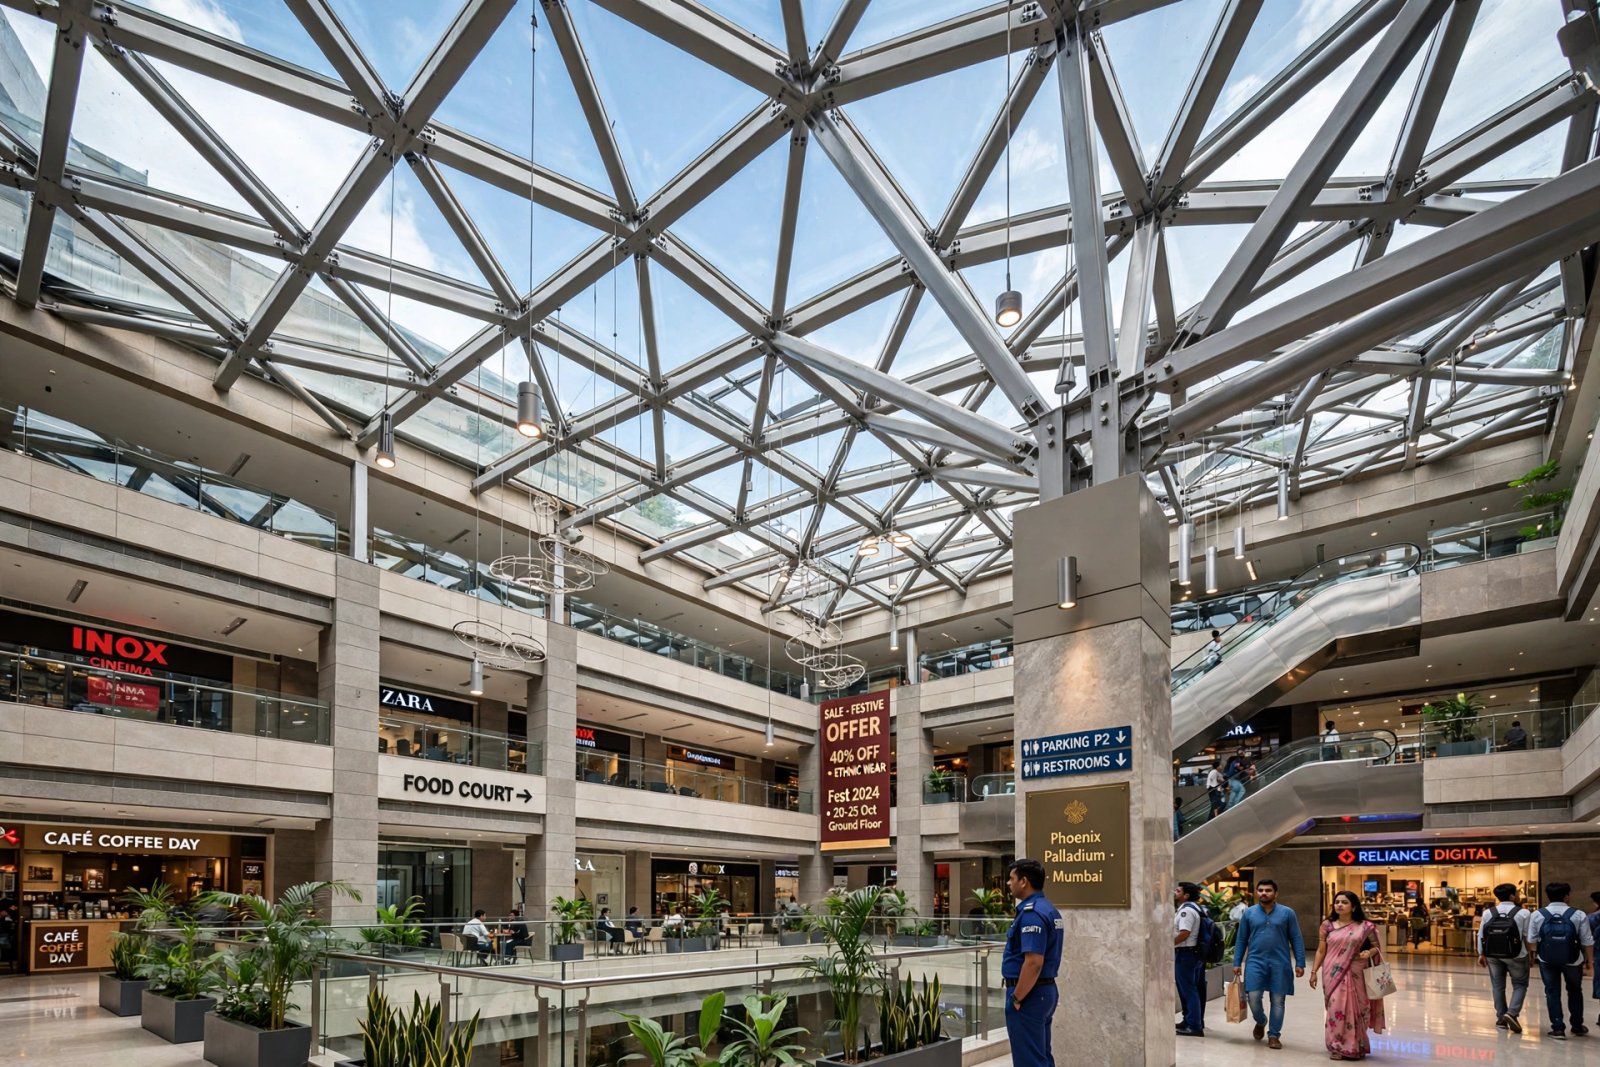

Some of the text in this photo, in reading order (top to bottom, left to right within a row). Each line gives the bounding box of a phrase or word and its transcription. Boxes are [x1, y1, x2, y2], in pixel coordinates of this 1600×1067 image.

[73, 627, 168, 665] INOX
[382, 689, 434, 712] ZARA
[824, 707, 844, 720] SALE
[851, 699, 884, 715] FESTIVE
[826, 716, 881, 742] OFFER
[1042, 733, 1110, 753] PARKING P2
[829, 744, 880, 764] 40% OFF
[863, 762, 887, 775] WEAR
[1043, 755, 1110, 773] RESTROOMS
[404, 774, 514, 802] FOOD COURT
[828, 785, 880, 803] Fest 2024
[833, 804, 877, 818] 20-25 Oct
[828, 819, 882, 831] Ground Floor
[44, 830, 200, 850] CAFÉ COFFEE DAY
[1050, 830, 1101, 845] Phoenix
[1044, 848, 1105, 863] Palladium
[1358, 848, 1498, 862] RELIANCE DIGITAL
[1052, 869, 1102, 883] Mumbai
[44, 929, 79, 942] CAFÉ
[39, 942, 84, 953] COFFEE
[49, 952, 74, 964] DAY
